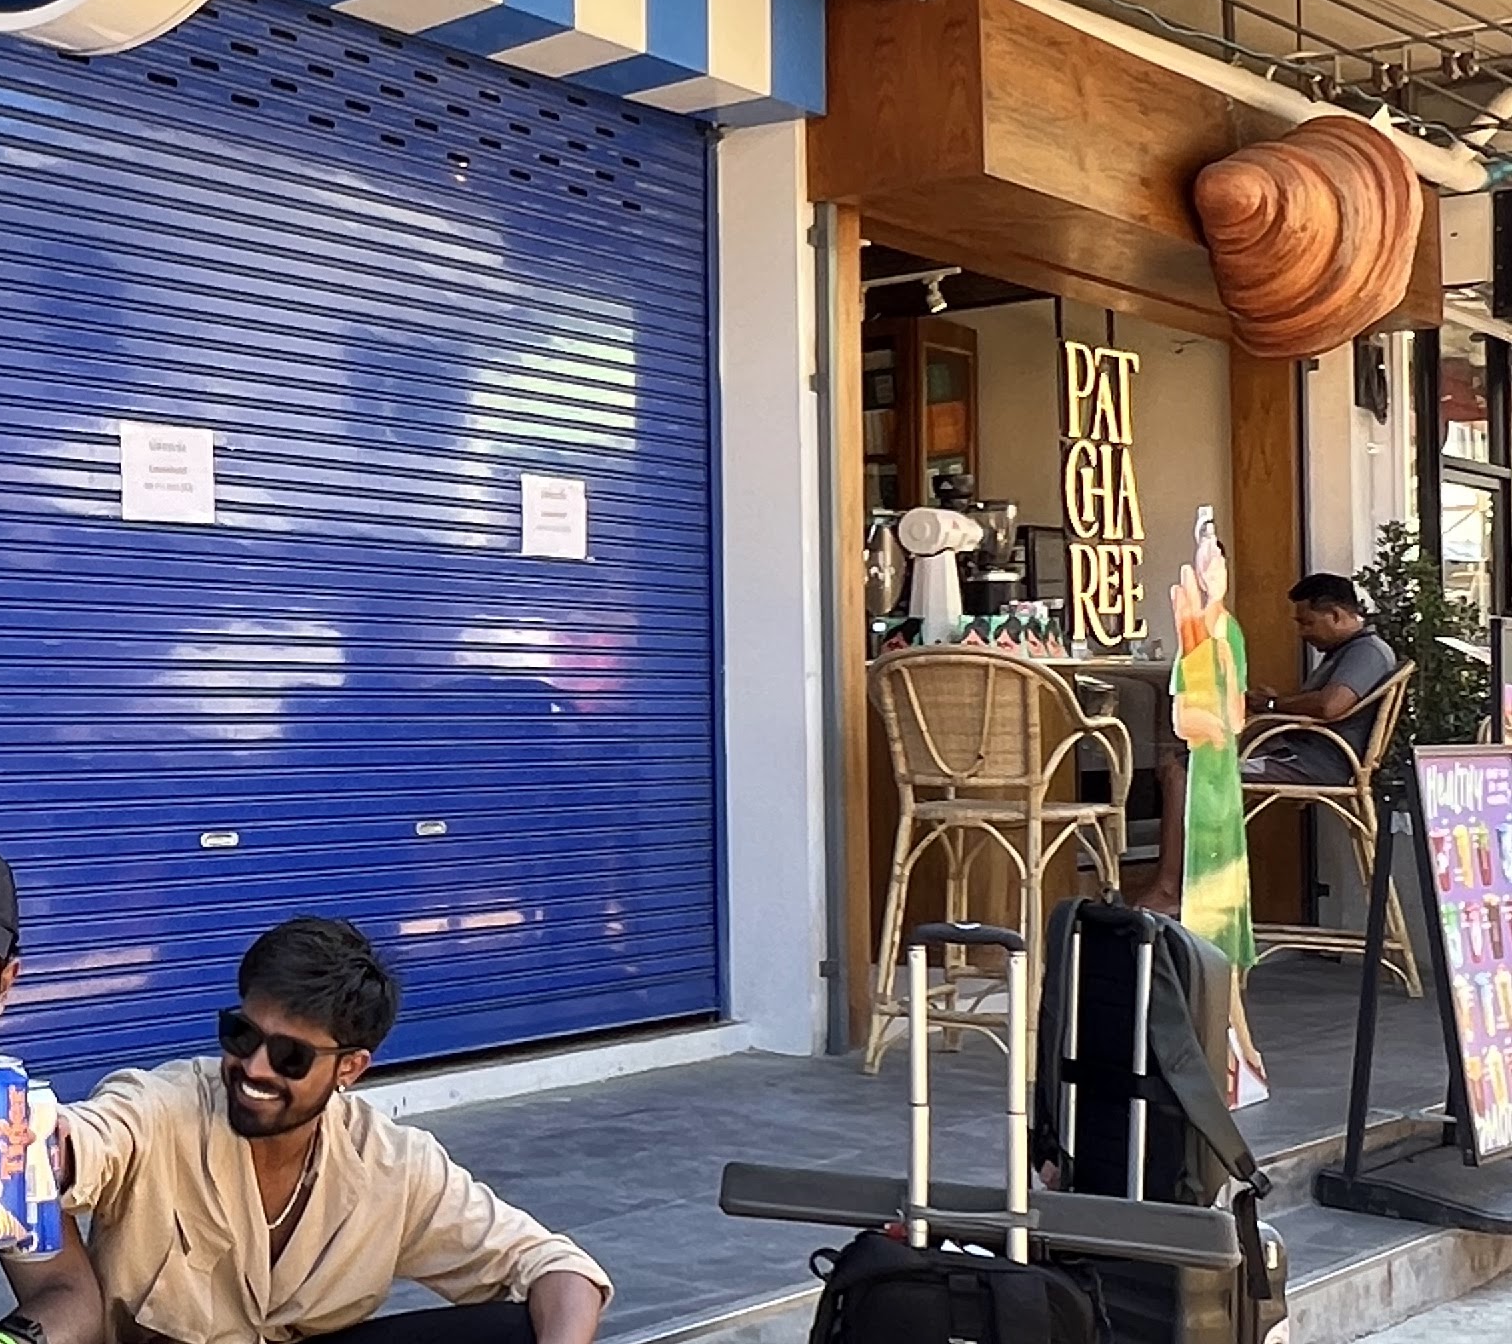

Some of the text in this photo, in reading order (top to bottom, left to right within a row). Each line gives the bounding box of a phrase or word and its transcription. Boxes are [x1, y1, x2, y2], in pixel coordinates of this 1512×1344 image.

[1064, 340, 1140, 445] PAT
[1065, 439, 1145, 541] CHA
[1068, 542, 1148, 647] REE
